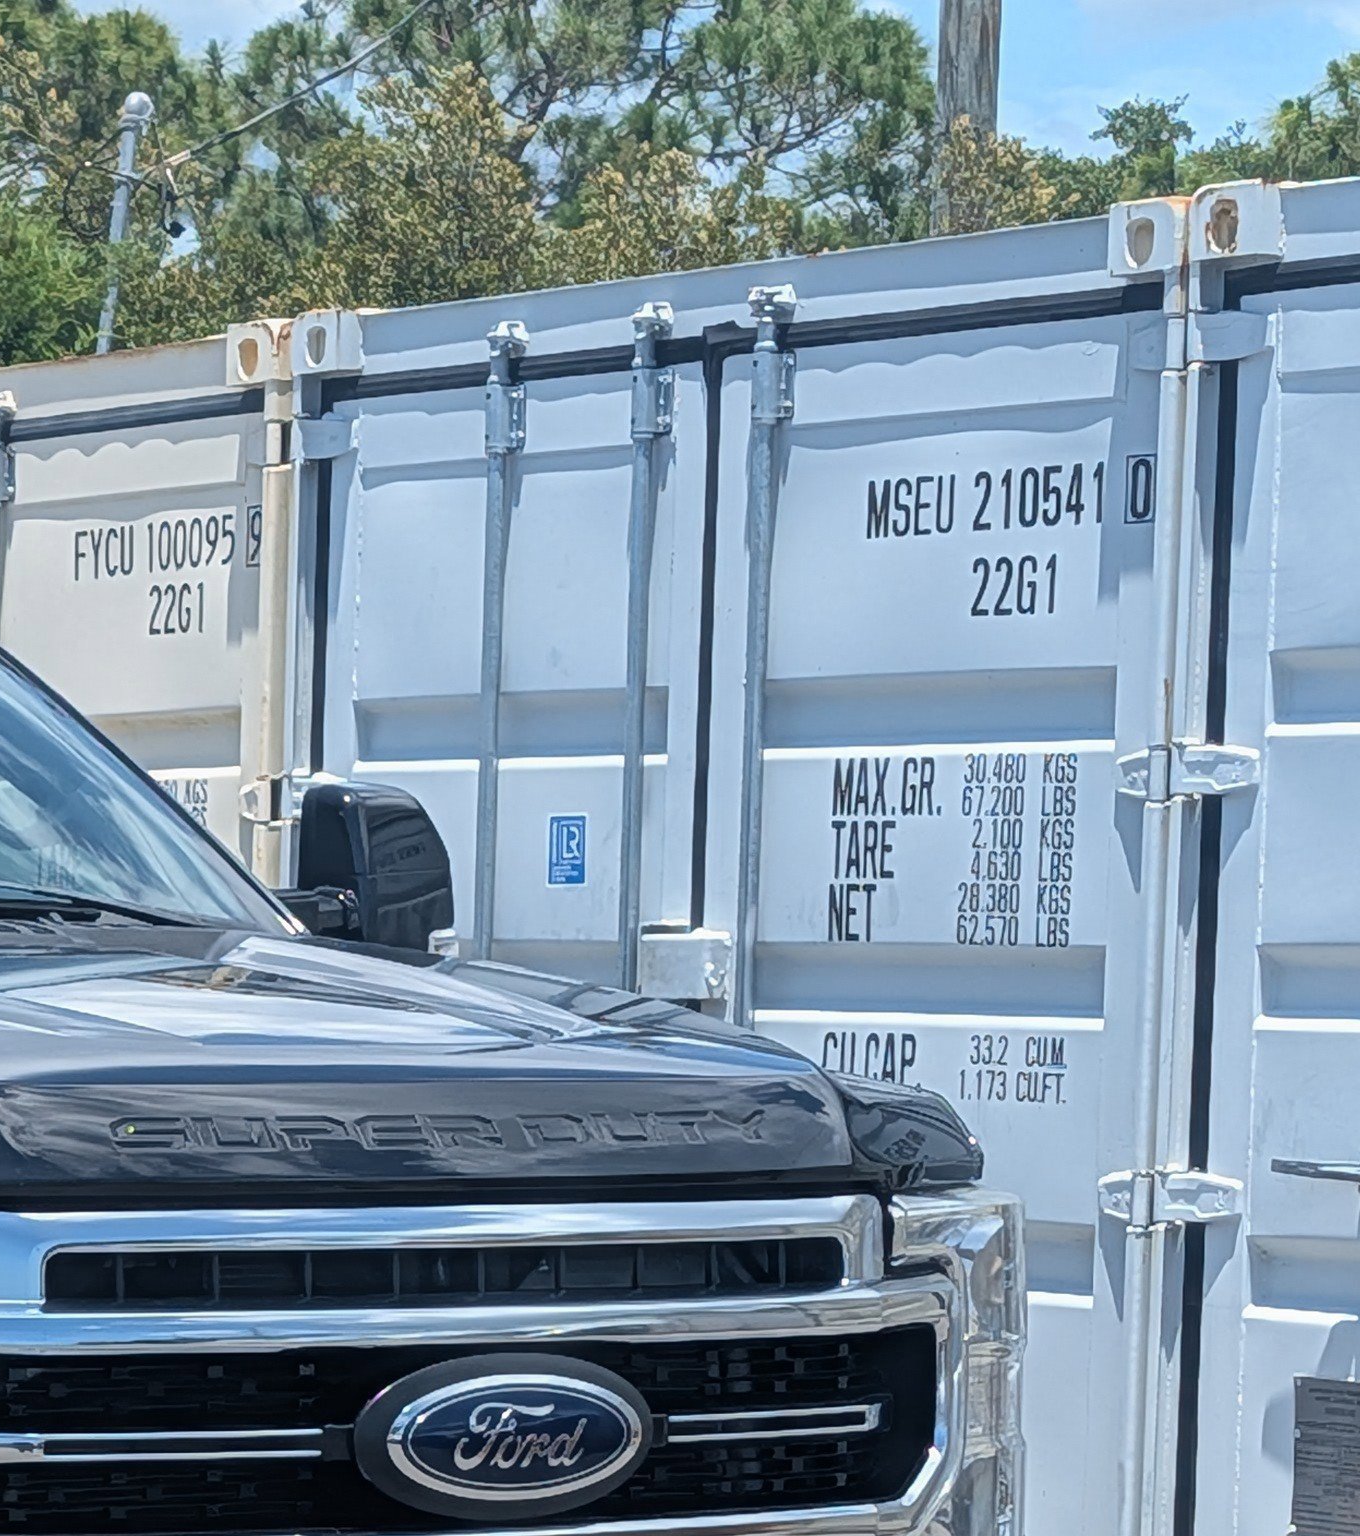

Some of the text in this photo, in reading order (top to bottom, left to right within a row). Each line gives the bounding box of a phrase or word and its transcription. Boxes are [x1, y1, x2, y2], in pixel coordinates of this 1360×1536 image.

[866, 458, 1153, 539] MSEU 210541 0
[74, 510, 262, 581] FYCU 100095 9
[148, 581, 204, 635] 22G1
[970, 553, 1057, 616] 22G1
[831, 752, 1078, 817] MAX.GR. 30.480 KGS
[961, 785, 1077, 817] 67.200 LBS
[831, 817, 1075, 880] TARE 2.100 KGS
[970, 850, 1073, 882] 4.630 LBS
[827, 881, 1071, 943] NET 28.380 KGS
[956, 914, 1070, 948] 62.570 LBS
[969, 1034, 1009, 1066] 33.2
[959, 1068, 1007, 1102] 1.173
[108, 1109, 767, 1152] SUPER DUTY
[454, 1402, 587, 1471] Ford
